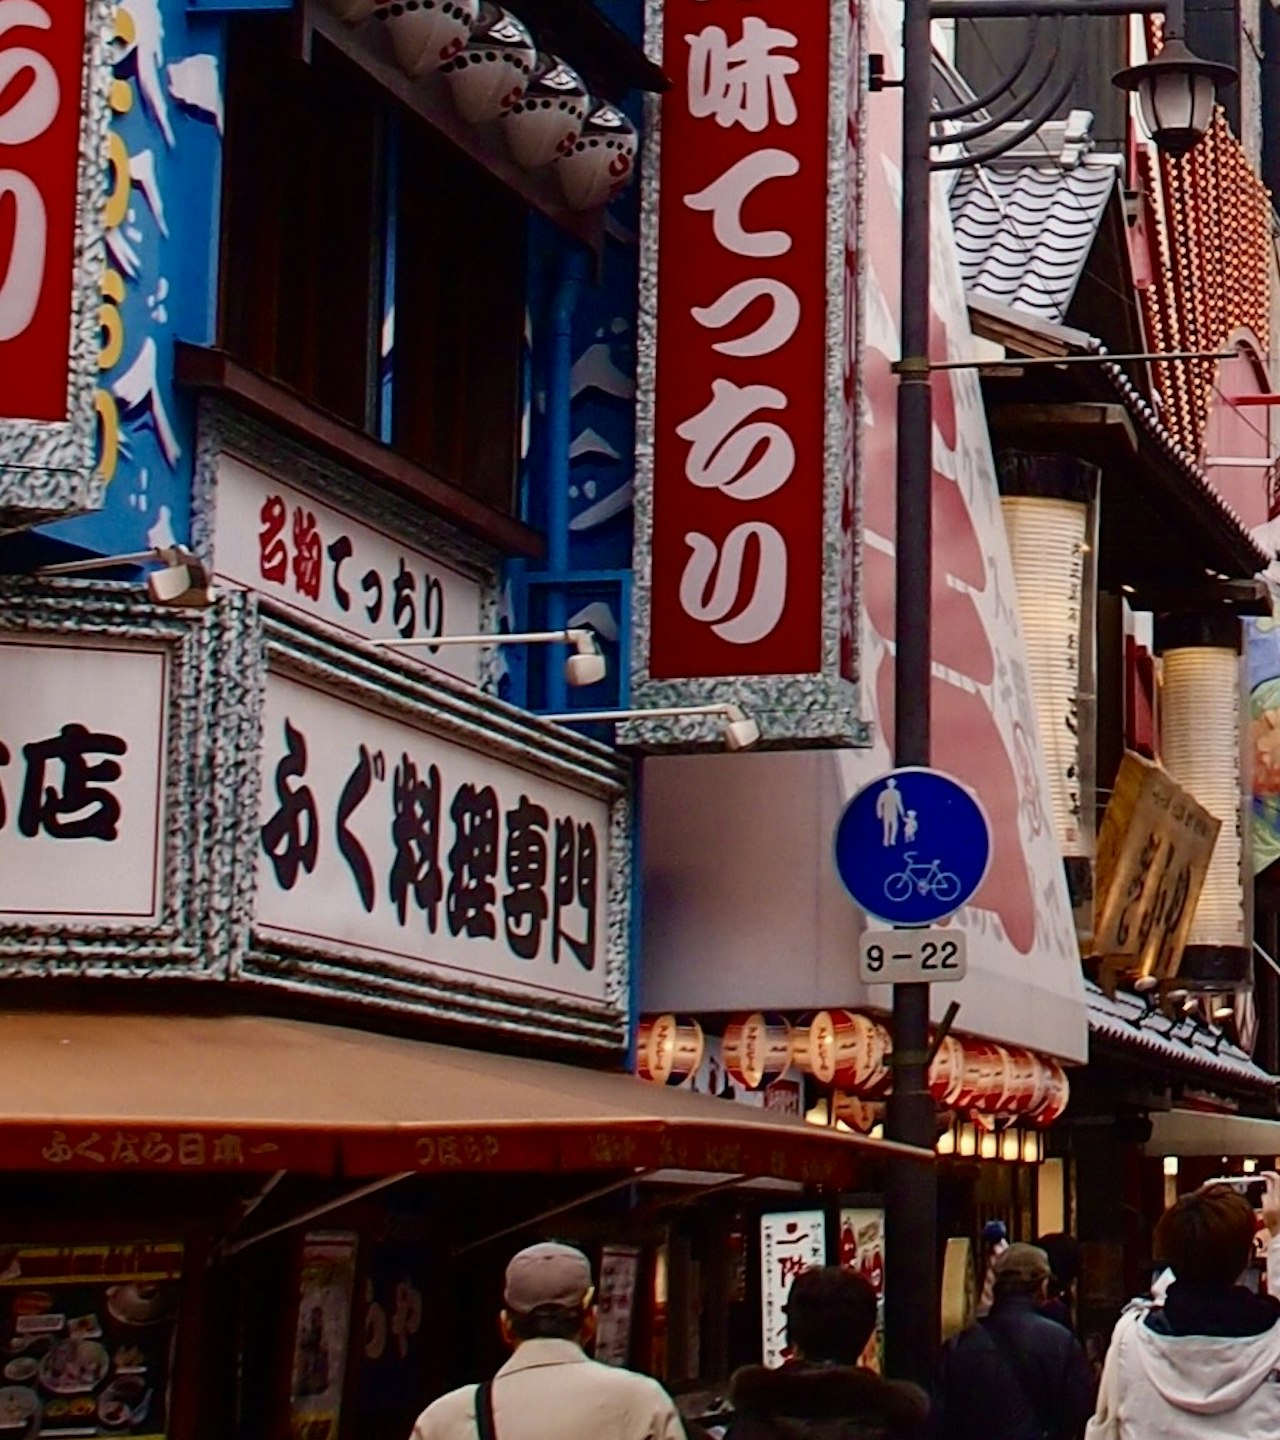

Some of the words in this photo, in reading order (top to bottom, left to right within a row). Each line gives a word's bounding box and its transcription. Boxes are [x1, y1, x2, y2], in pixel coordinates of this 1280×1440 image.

[259, 495, 446, 652] 名物てっちり
[0, 723, 126, 841] 店
[261, 718, 596, 971] ふぐ料理専門
